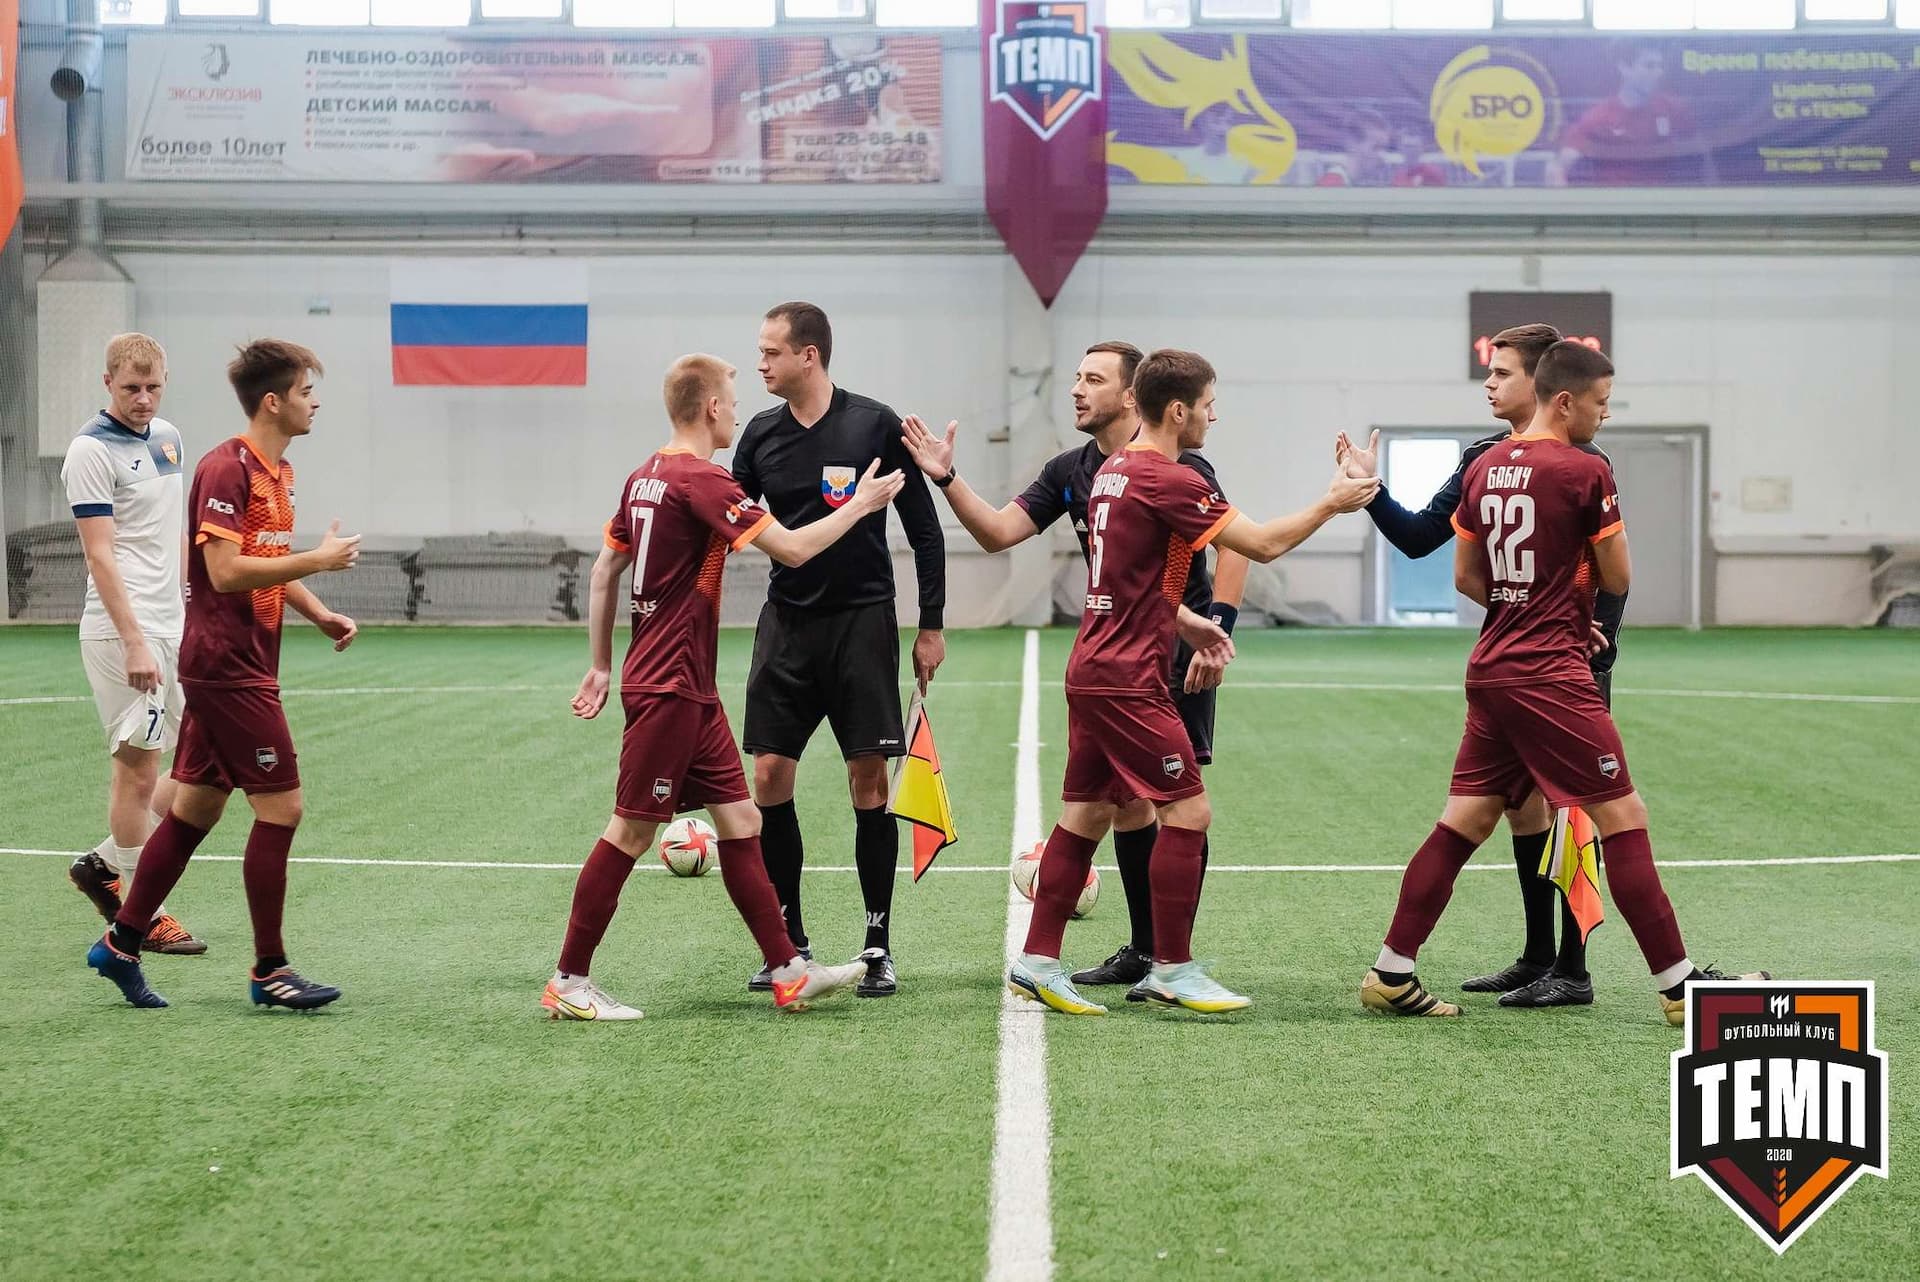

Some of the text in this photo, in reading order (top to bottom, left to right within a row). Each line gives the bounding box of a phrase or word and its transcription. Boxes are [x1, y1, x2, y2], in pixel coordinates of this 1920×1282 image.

[1001, 37, 1090, 85] ТЕМП
[306, 96, 397, 113] ДЕТСКИЙ
[141, 135, 287, 156] более 10лет
[1487, 466, 1533, 490] БАБИЧ
[1480, 494, 1536, 583] 22
